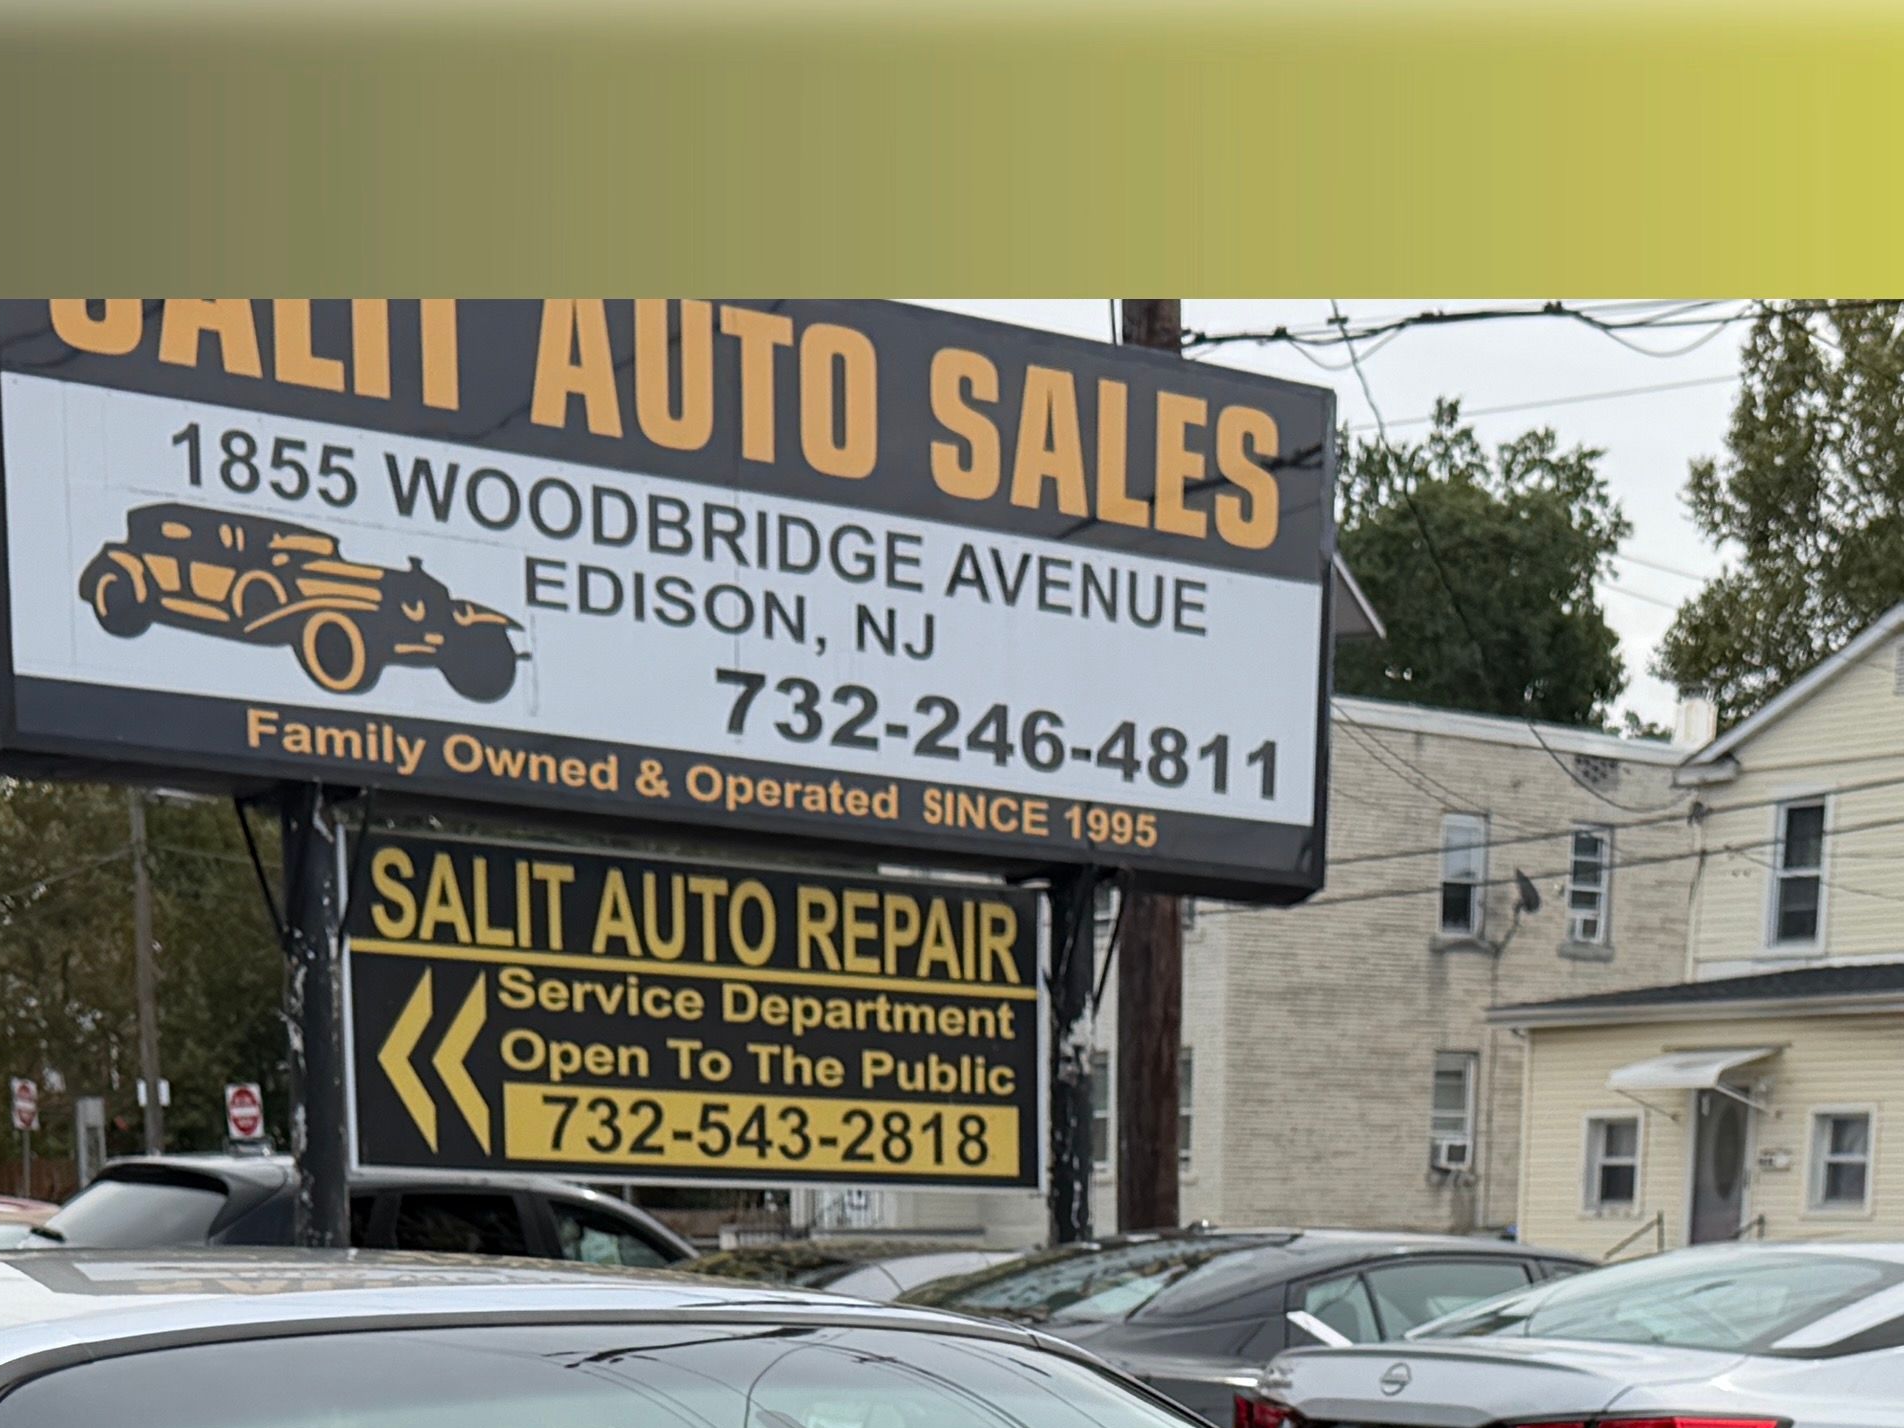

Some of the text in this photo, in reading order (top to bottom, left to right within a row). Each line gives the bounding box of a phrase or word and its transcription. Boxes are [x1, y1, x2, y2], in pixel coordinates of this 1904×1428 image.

[530, 299, 877, 479] AUTO
[930, 347, 1279, 550] SALES
[172, 422, 1208, 637] 1855 WOODBRIDGE AVENUE
[525, 556, 936, 660] EDISON, NJ
[247, 708, 1158, 849] Family Owned & Operated SINCE 1995
[716, 668, 1278, 800] 732-246-4811
[371, 846, 1021, 984] SALIT AUTO REPAIR
[498, 966, 1016, 1040] Service Department
[500, 1028, 1016, 1095] Open To The Public
[542, 1094, 990, 1167] 732-543-2818
